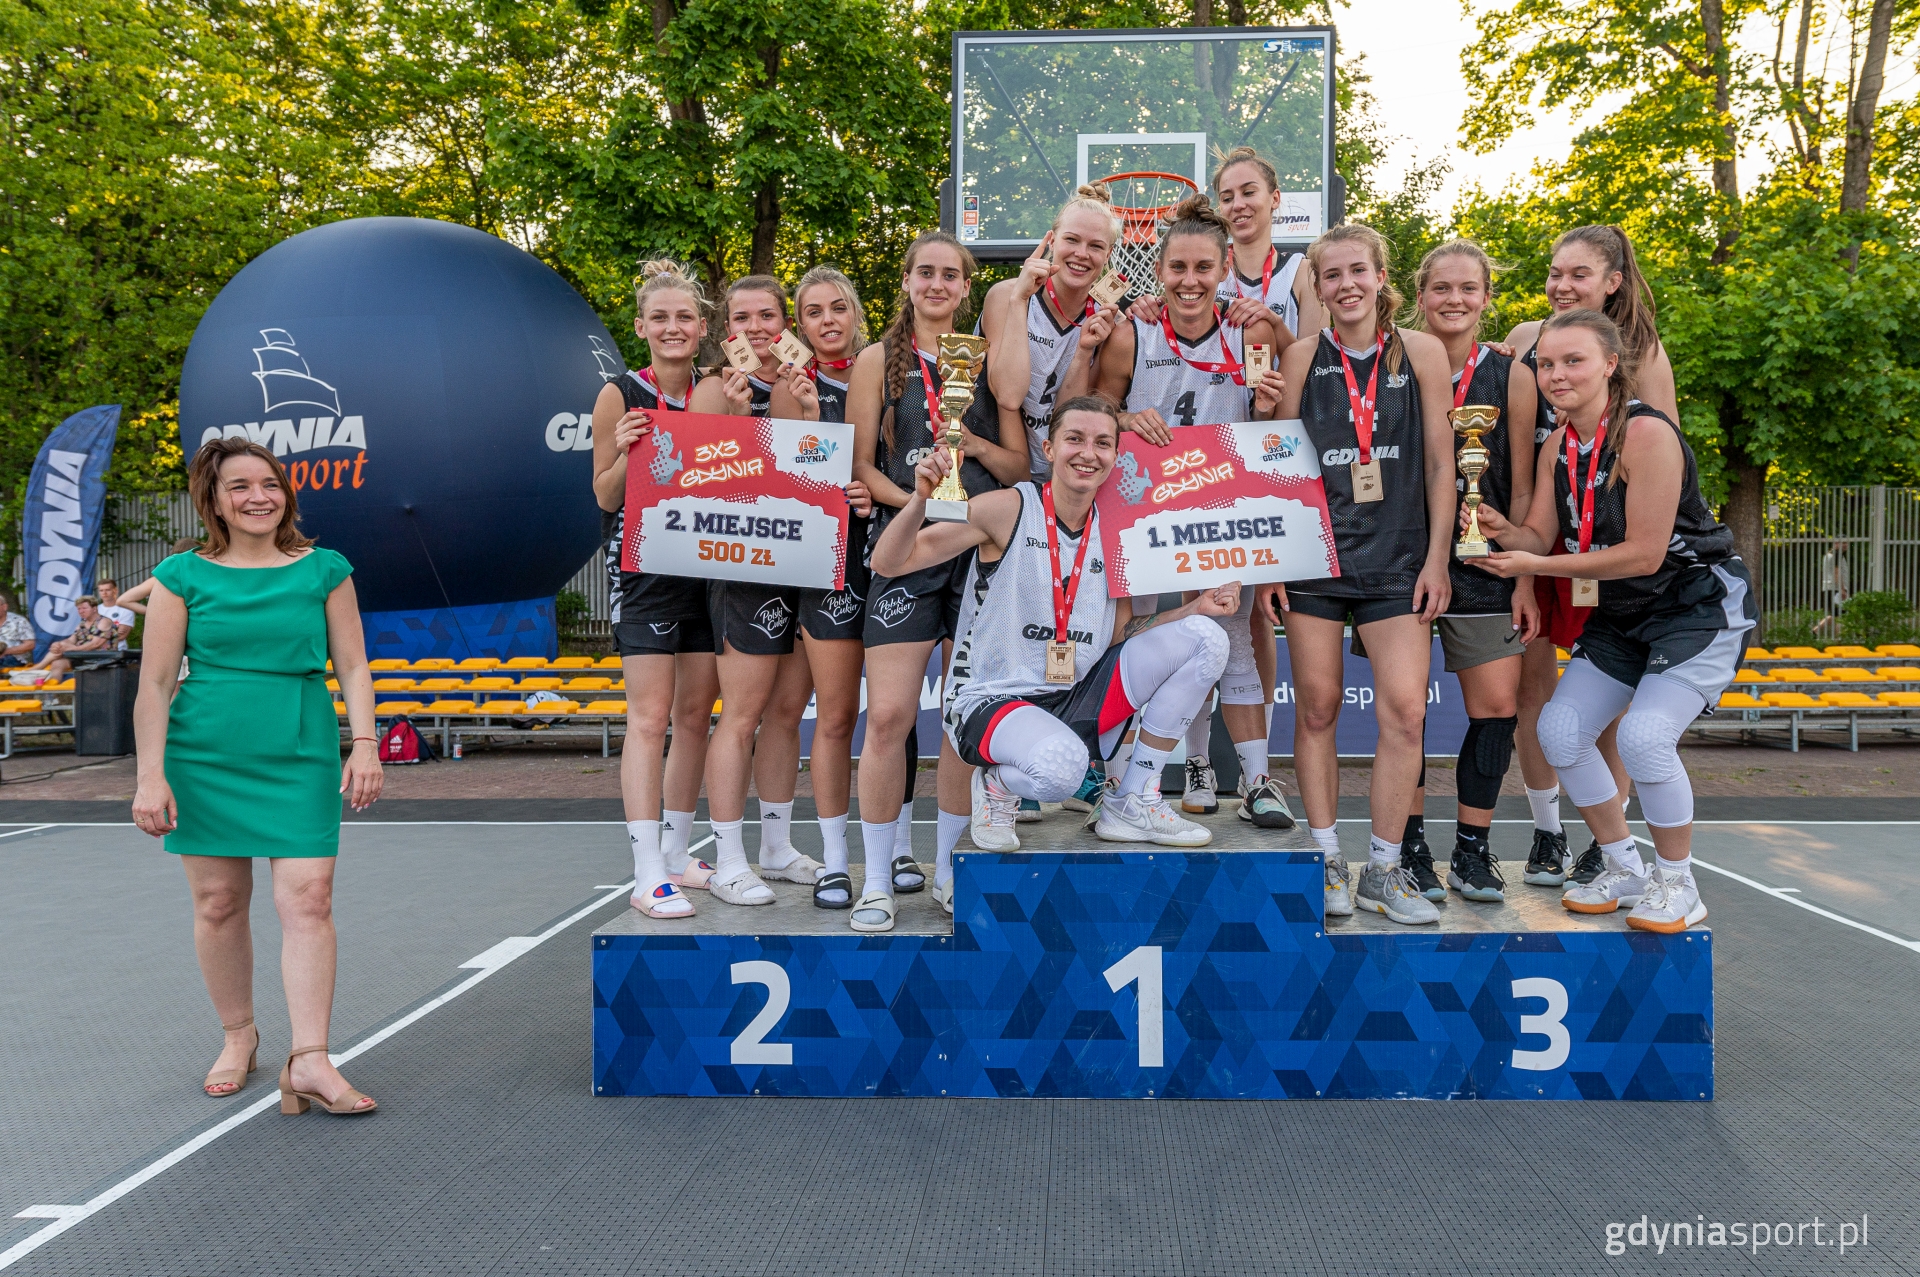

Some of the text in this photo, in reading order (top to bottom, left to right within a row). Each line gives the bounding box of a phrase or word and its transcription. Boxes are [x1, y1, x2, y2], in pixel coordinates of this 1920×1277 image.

[1288, 223, 1310, 232] sport
[1145, 356, 1181, 369] SPALDING
[1314, 365, 1345, 376] SPALDIN
[1173, 391, 1198, 426] 4
[795, 455, 828, 463] GDYNIA
[1262, 451, 1294, 462] GDYNIA
[680, 458, 764, 488] GDYNIA
[1152, 462, 1234, 503] GDYNIA
[664, 509, 804, 542] 2. MIEJSCE
[1146, 515, 1287, 549] 1. MIEJSCE
[33, 449, 88, 637] GDYNIA
[698, 540, 746, 563] 500
[1174, 551, 1192, 573] 2
[1196, 547, 1248, 571] 500
[827, 593, 852, 610] Polski
[833, 604, 858, 618] Cukier
[883, 603, 912, 620] Cukier
[760, 607, 783, 624] Polski
[767, 616, 789, 631] Cukier
[730, 960, 793, 1065] 2
[1102, 945, 1164, 1067] 1
[1511, 976, 1571, 1071] 3
